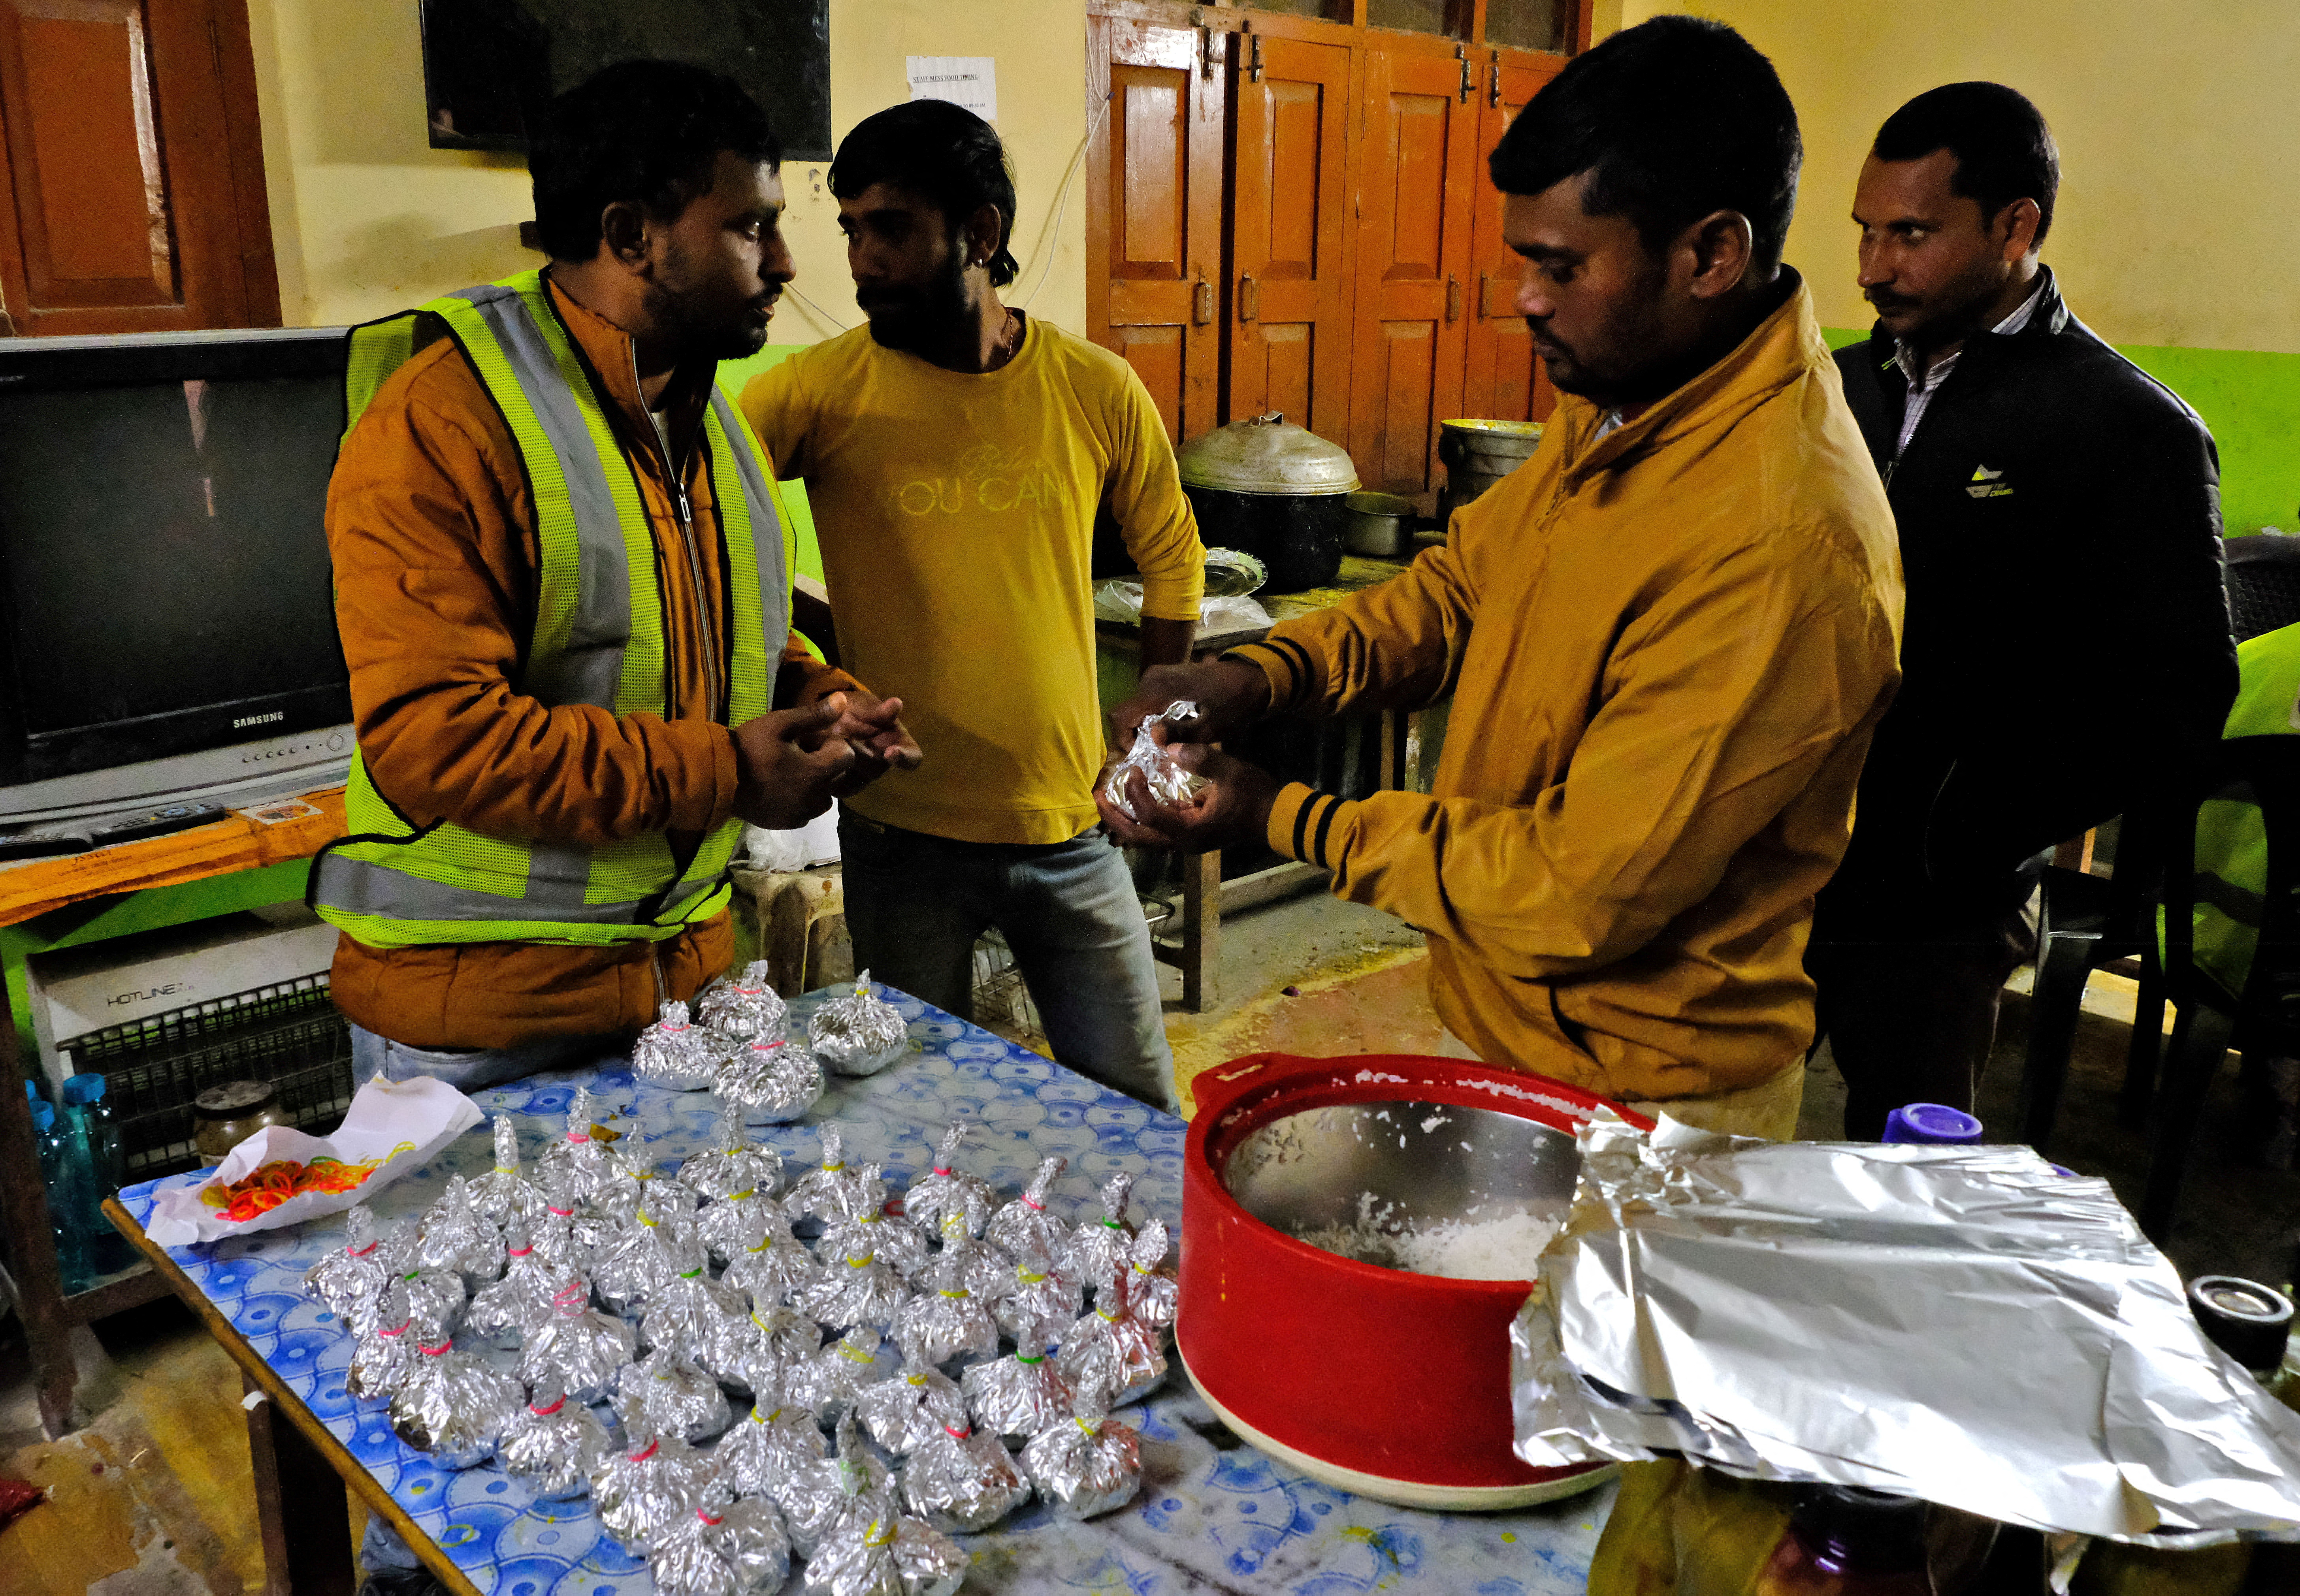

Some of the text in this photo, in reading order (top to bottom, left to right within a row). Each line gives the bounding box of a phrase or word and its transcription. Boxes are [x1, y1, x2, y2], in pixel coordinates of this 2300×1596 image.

[978, 473, 1068, 511] CAN
[233, 711, 284, 728] SAMSUNG
[107, 983, 176, 1007] HOTLINE
